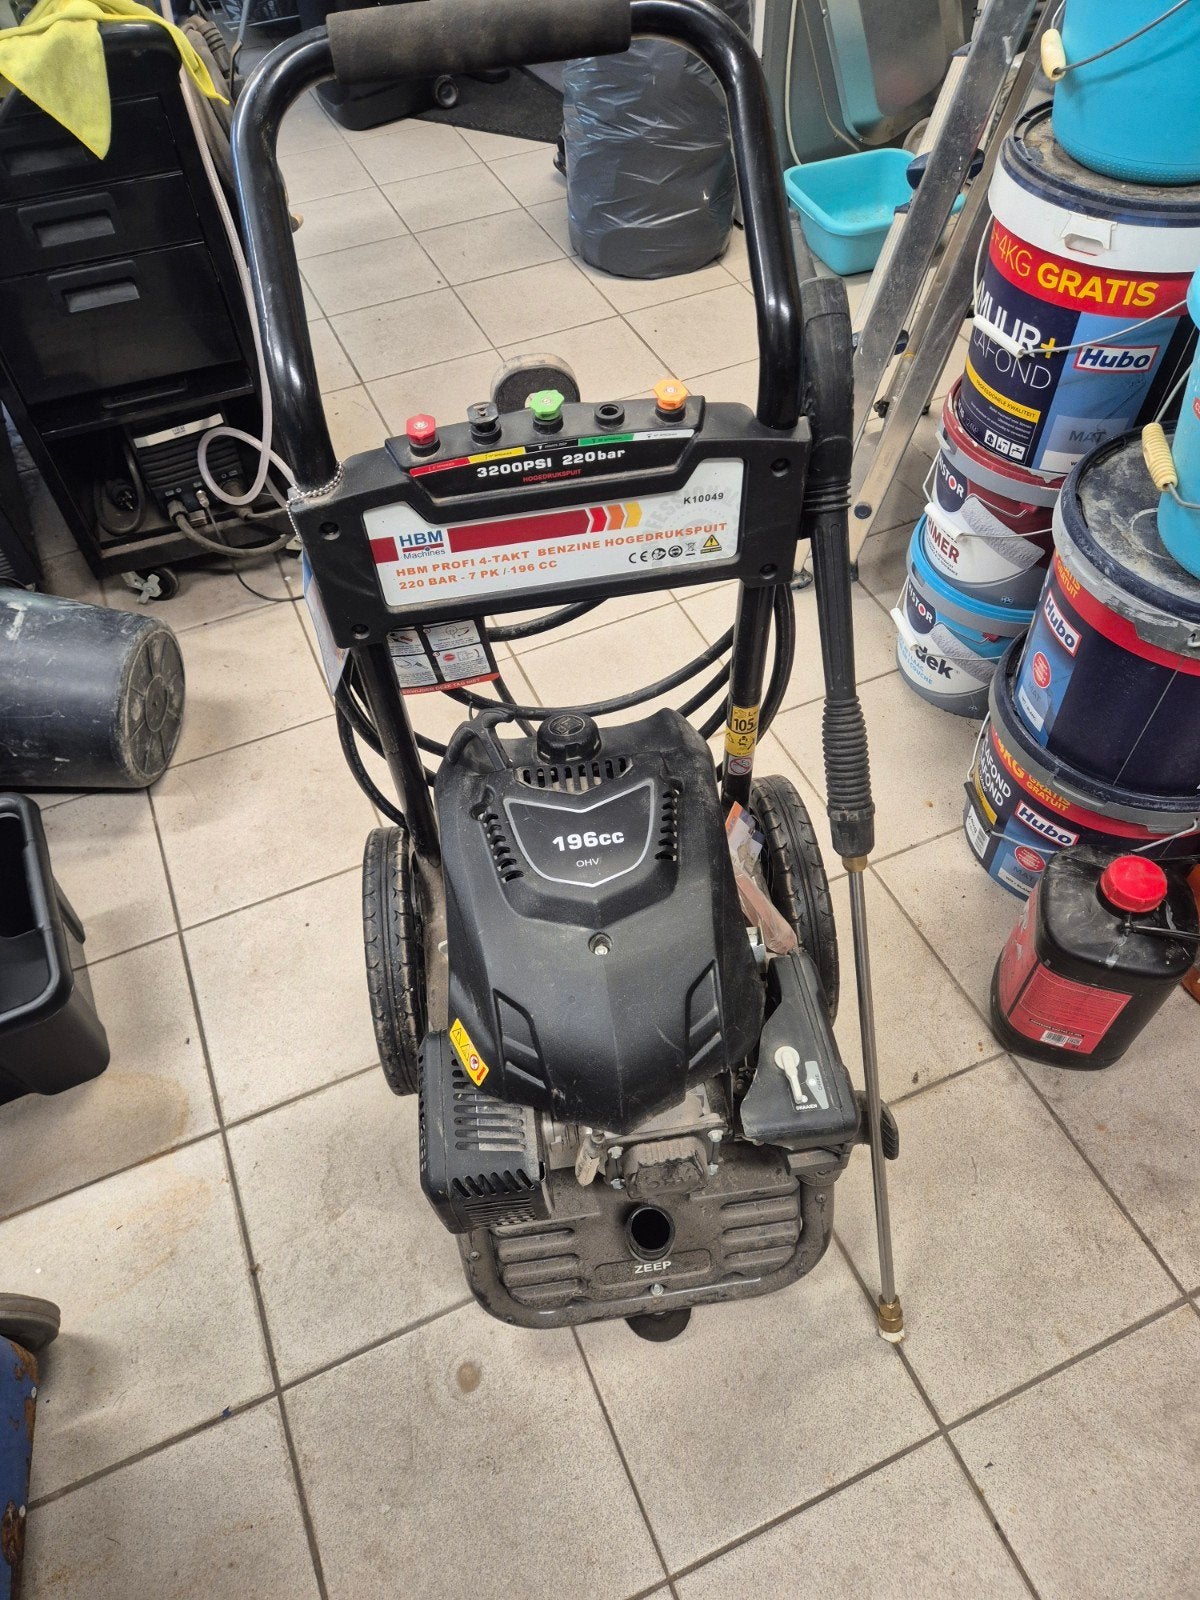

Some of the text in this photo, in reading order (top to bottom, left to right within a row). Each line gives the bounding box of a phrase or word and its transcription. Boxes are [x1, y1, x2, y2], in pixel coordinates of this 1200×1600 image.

[1037, 262, 1159, 307] GRATIS
[1079, 348, 1151, 368] Hubo
[1007, 401, 1036, 418] KWALITEIT
[476, 458, 552, 478] 3200PSI
[523, 469, 582, 483] HOGEDRUKSPUIT
[683, 492, 724, 505] K10049
[399, 530, 443, 547] HBM
[396, 522, 728, 577] HBM PROFI 4-TAKT BENZINE HOGEDRUKSPUIT
[403, 547, 446, 560] Machines
[399, 579, 425, 590] 220
[428, 574, 457, 586] BAR
[468, 571, 476, 580] 7
[481, 568, 500, 579] PK
[538, 560, 557, 570] CC
[1045, 598, 1075, 649] Hubo
[733, 718, 754, 732] 105
[1019, 806, 1072, 845] Hubo
[552, 831, 625, 851] 196cc
[576, 857, 600, 868] OHV
[634, 1260, 672, 1275] ZEEP
